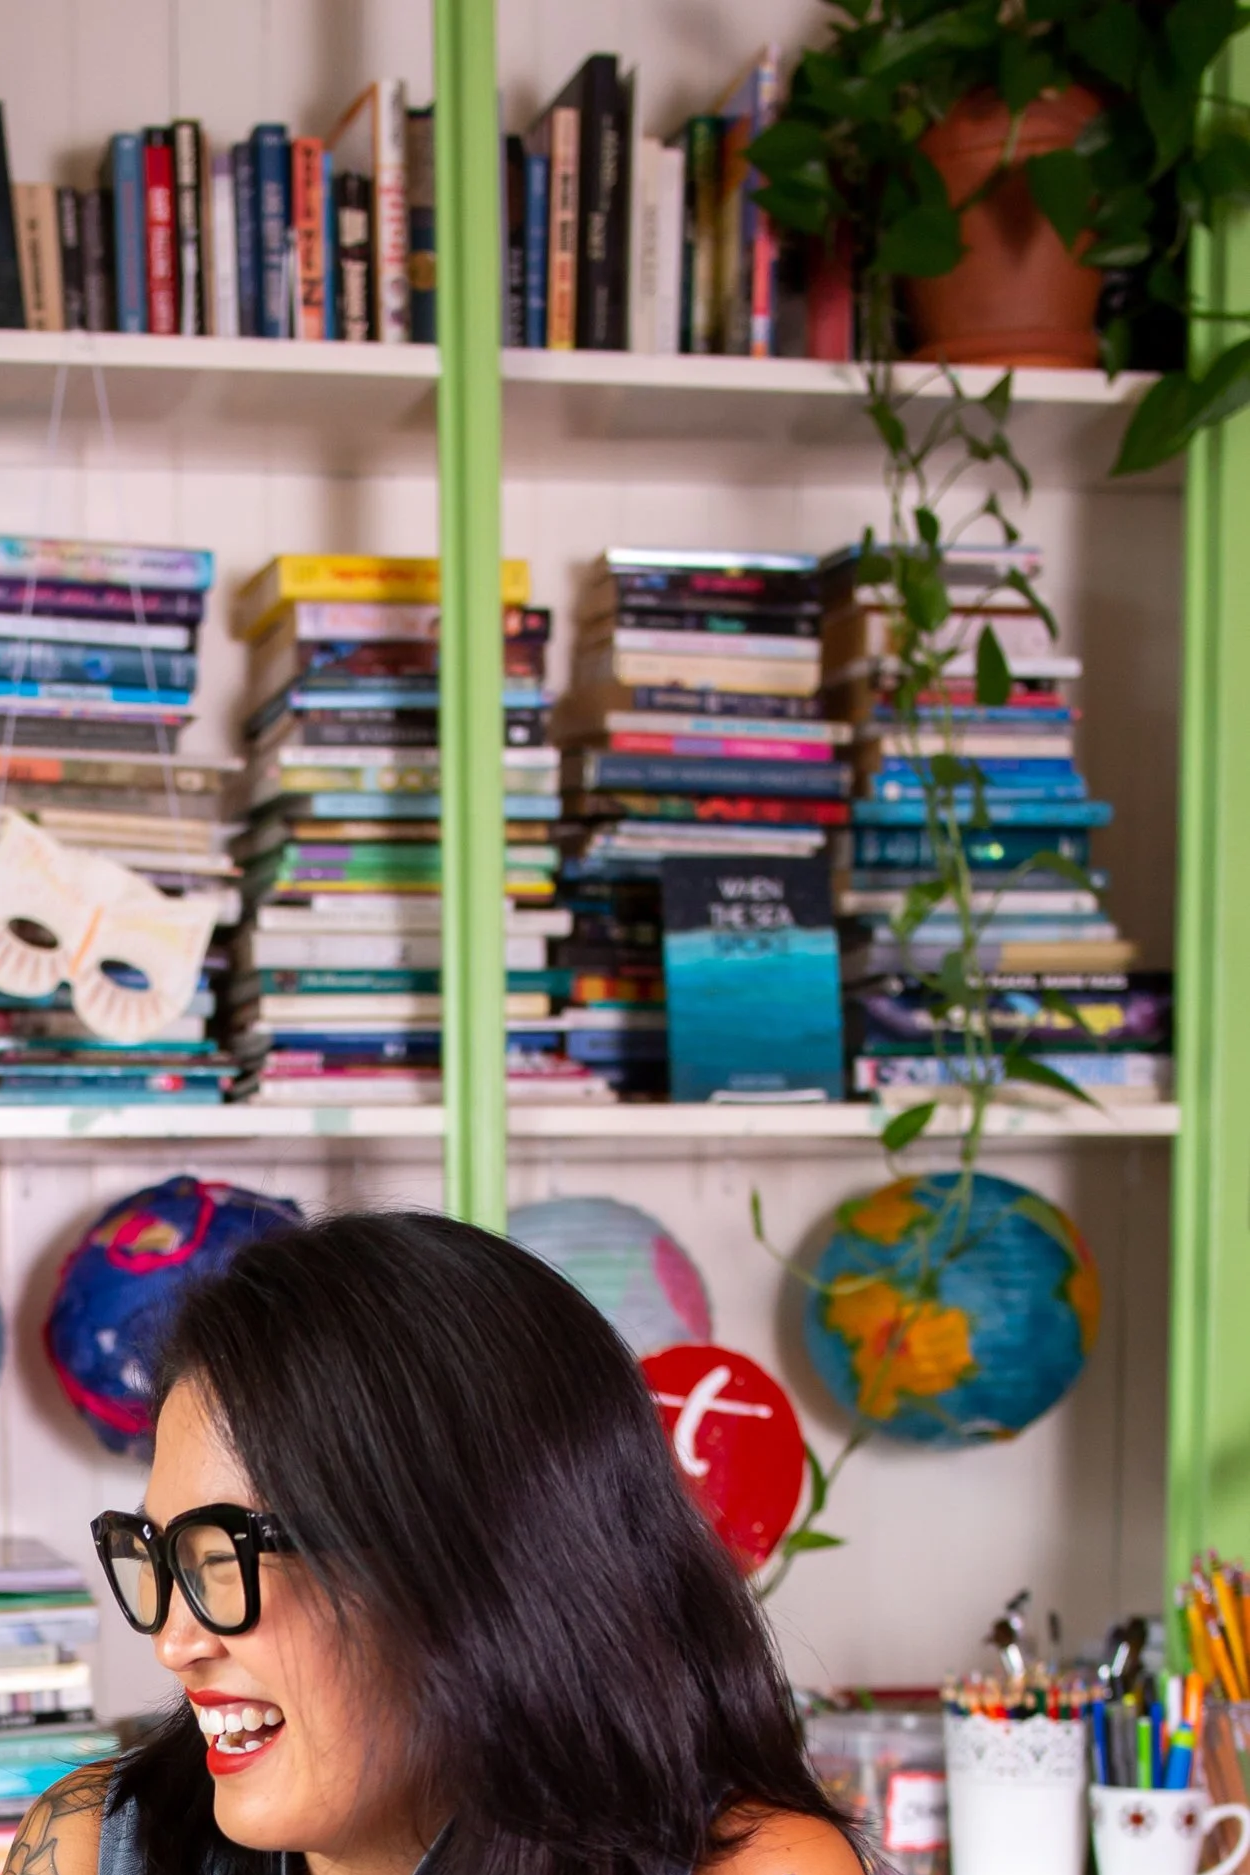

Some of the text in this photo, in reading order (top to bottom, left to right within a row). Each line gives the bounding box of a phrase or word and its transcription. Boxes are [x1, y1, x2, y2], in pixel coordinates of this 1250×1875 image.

[717, 876, 784, 900] WHEN
[708, 902, 796, 926] THE SEA
